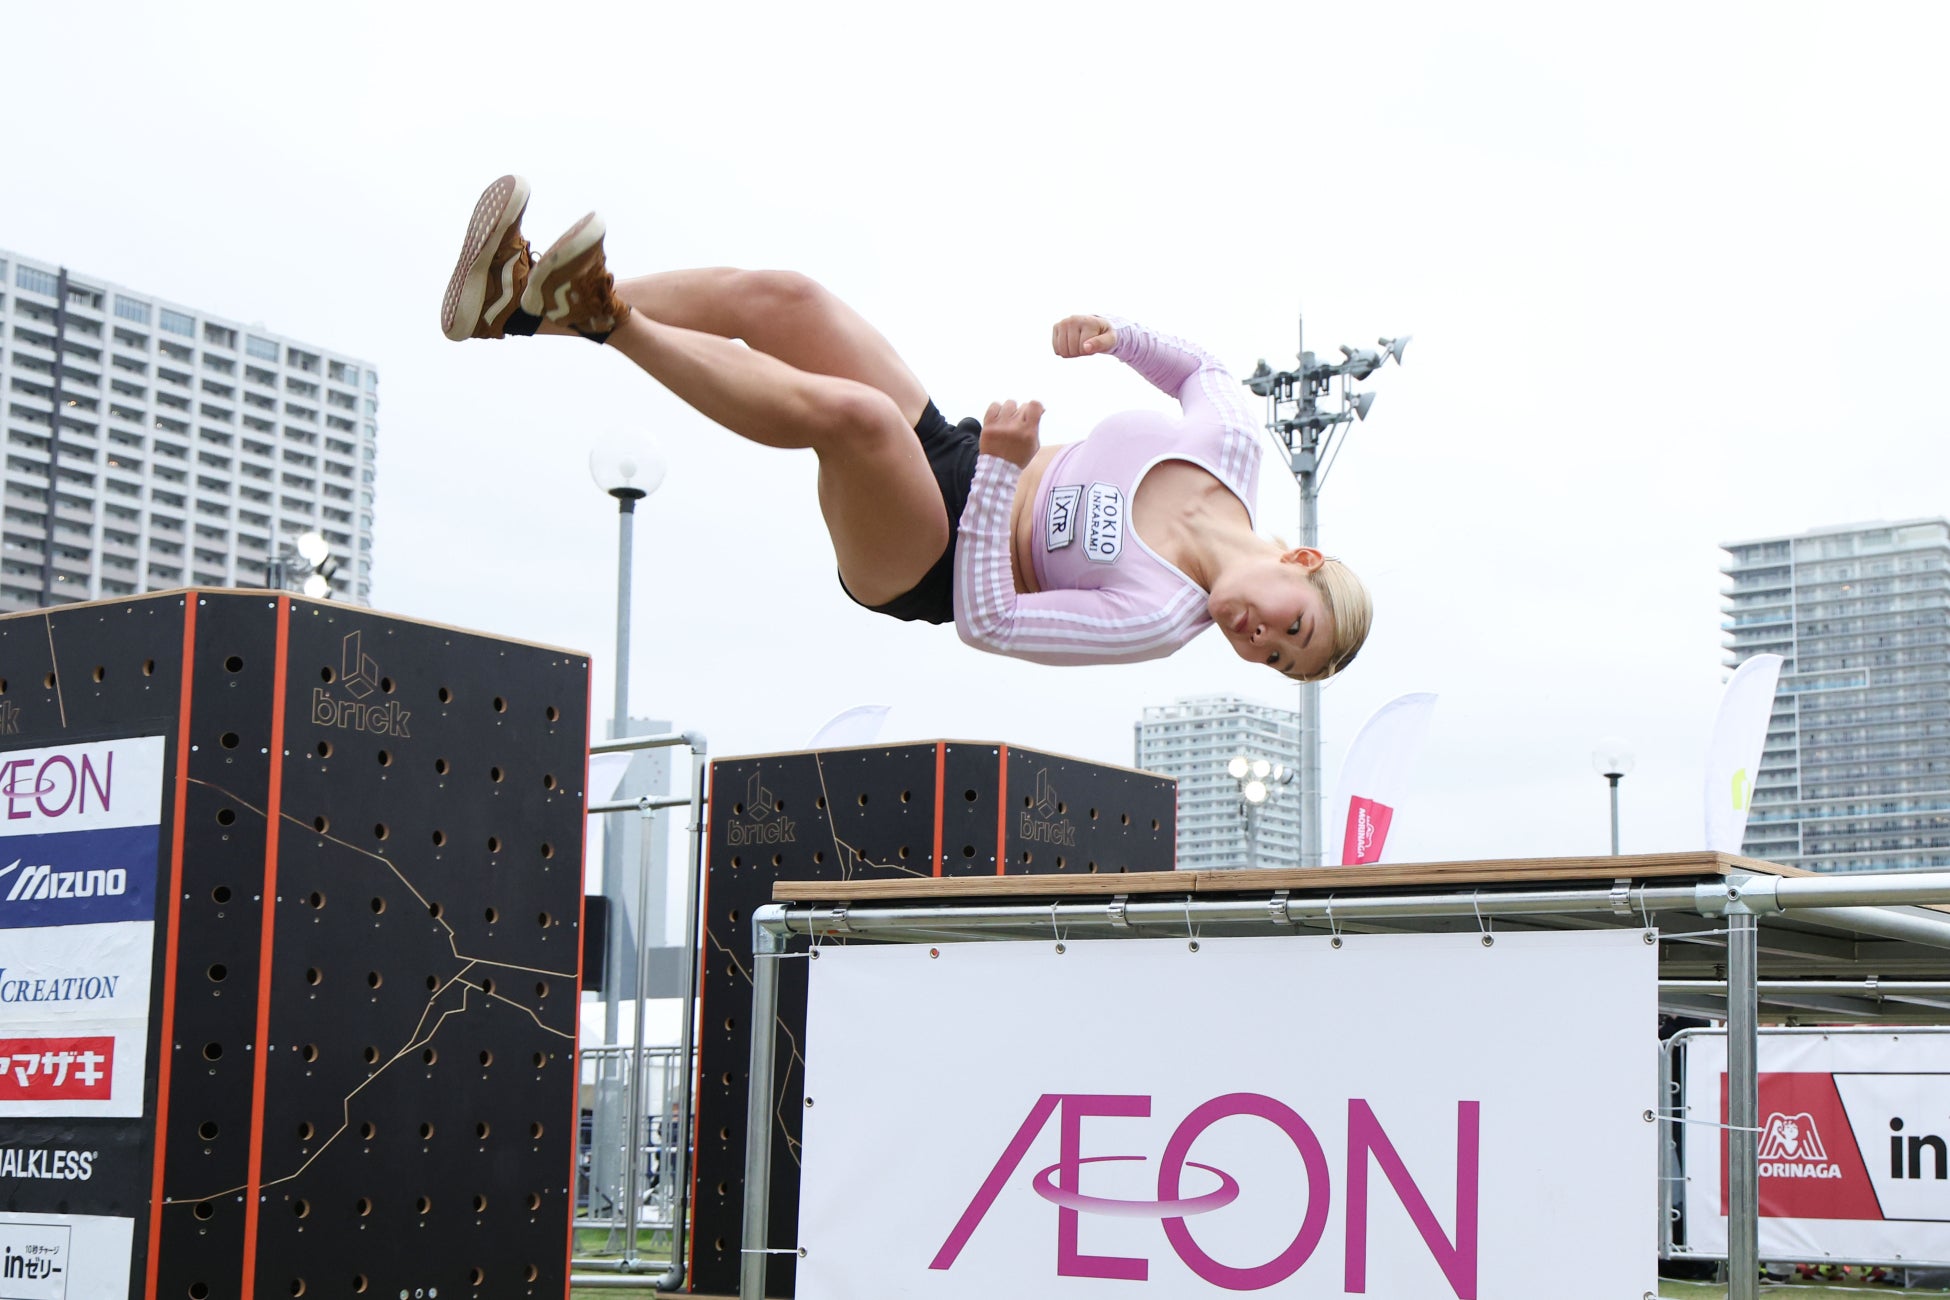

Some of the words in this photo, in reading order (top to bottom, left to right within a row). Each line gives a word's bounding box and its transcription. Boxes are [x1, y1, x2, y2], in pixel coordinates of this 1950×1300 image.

[1089, 490, 1102, 552] INKARAMI
[1101, 492, 1118, 555] TOKIO
[312, 687, 411, 738] brick
[727, 815, 796, 846] brick
[1020, 811, 1076, 847] brick
[0, 1149, 93, 1181] ALKLESS
[1757, 1162, 1842, 1179] ORINAGA
